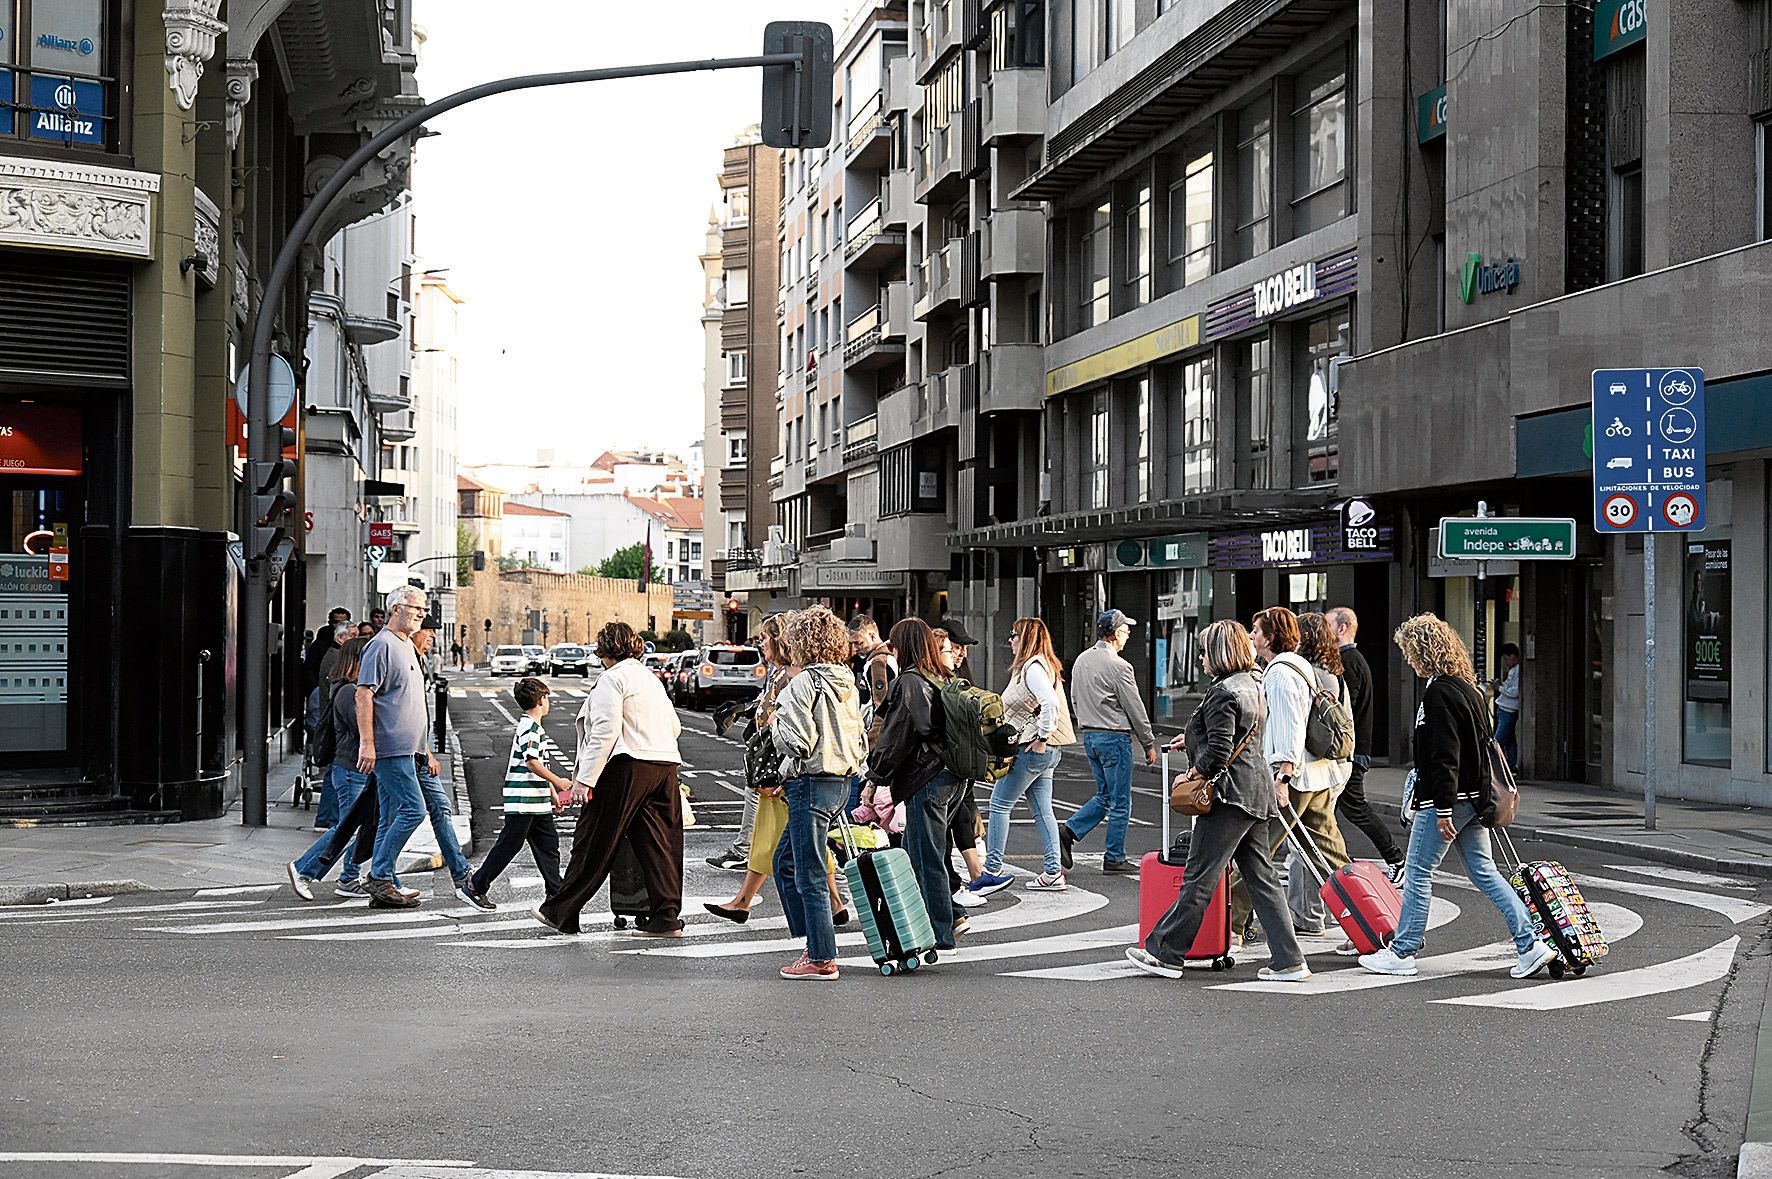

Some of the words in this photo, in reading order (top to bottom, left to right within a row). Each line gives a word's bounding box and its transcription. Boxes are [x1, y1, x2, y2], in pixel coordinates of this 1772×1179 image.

[40, 34, 77, 50] Allianz
[36, 112, 93, 135] Allianz
[1253, 273, 1283, 318] TACO
[1284, 262, 1316, 308] BELL
[1662, 448, 1695, 460] TAXI
[3, 459, 25, 468] JUEGO
[1663, 467, 1695, 478] BUS
[1610, 505, 1630, 517] 30
[371, 529, 392, 537] GAES
[1345, 527, 1377, 539] TACO
[1464, 527, 1498, 536] avenida
[1261, 530, 1286, 562] TACO
[1286, 528, 1312, 561] BELL
[1347, 538, 1377, 549] BELL
[15, 565, 48, 578] luckia
[20, 583, 29, 591] DE
[30, 583, 53, 591] JUEGO
[1695, 640, 1721, 662] 900€
